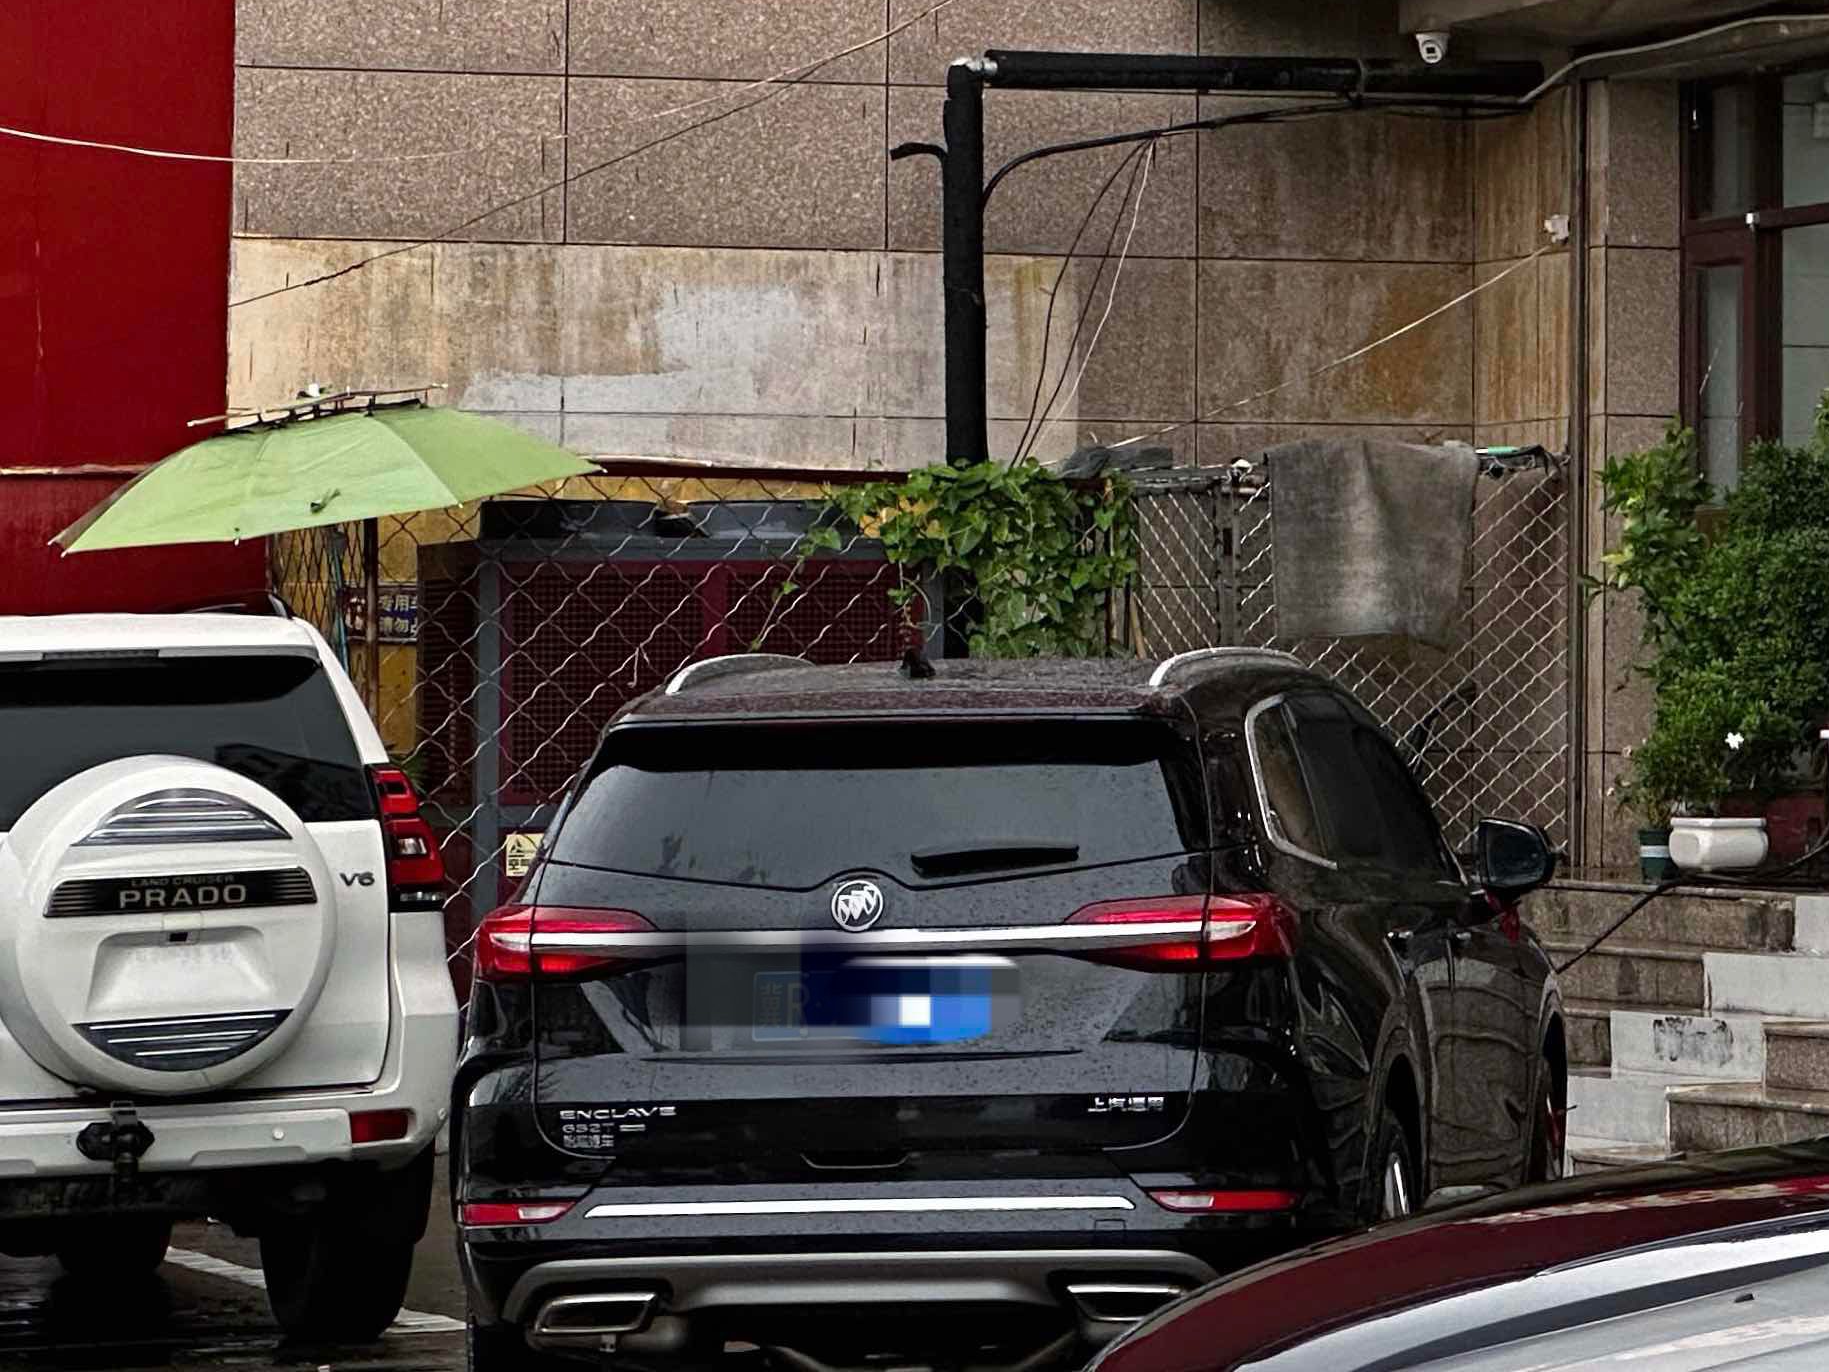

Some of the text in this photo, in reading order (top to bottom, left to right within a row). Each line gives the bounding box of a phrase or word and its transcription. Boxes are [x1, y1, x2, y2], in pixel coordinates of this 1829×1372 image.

[131, 877, 170, 888] LAND
[339, 871, 376, 887] V6
[119, 884, 248, 909] PRADO
[560, 1105, 677, 1120] ENCLAVE
